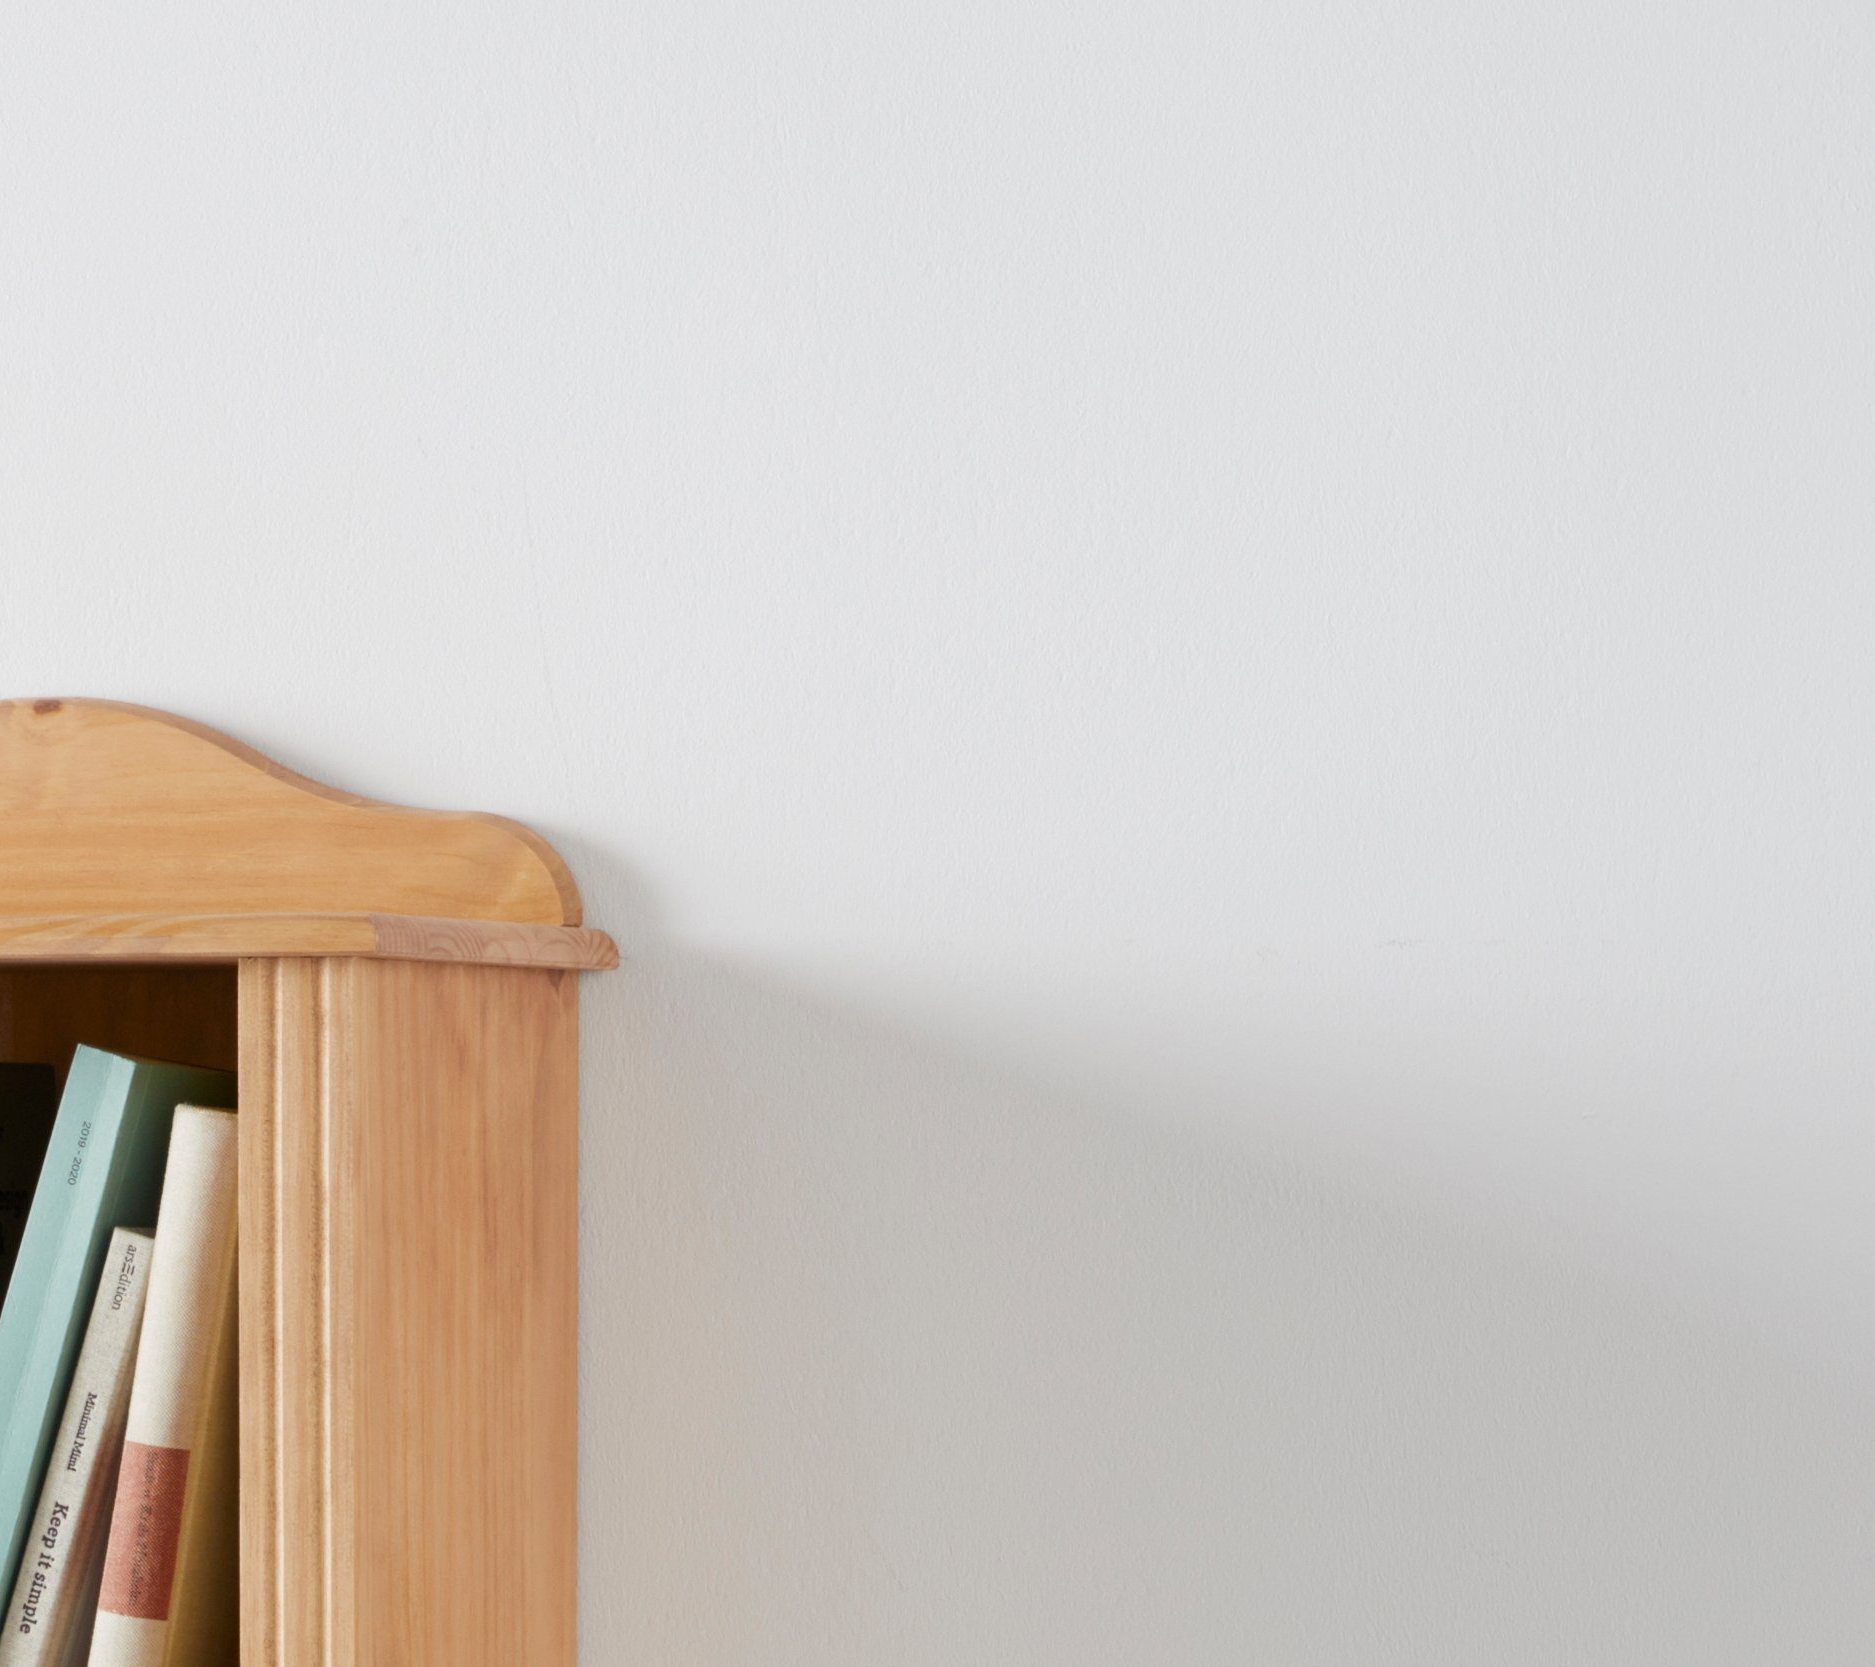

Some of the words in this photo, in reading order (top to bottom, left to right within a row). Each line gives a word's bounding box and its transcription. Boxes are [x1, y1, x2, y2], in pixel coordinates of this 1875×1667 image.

[80, 1121, 91, 1148] 2019
[67, 1157, 82, 1186] 2020
[76, 1392, 97, 1444] Minimal
[41, 1501, 69, 1549] Keep
[38, 1552, 55, 1570] it
[19, 1572, 47, 1634] simple
